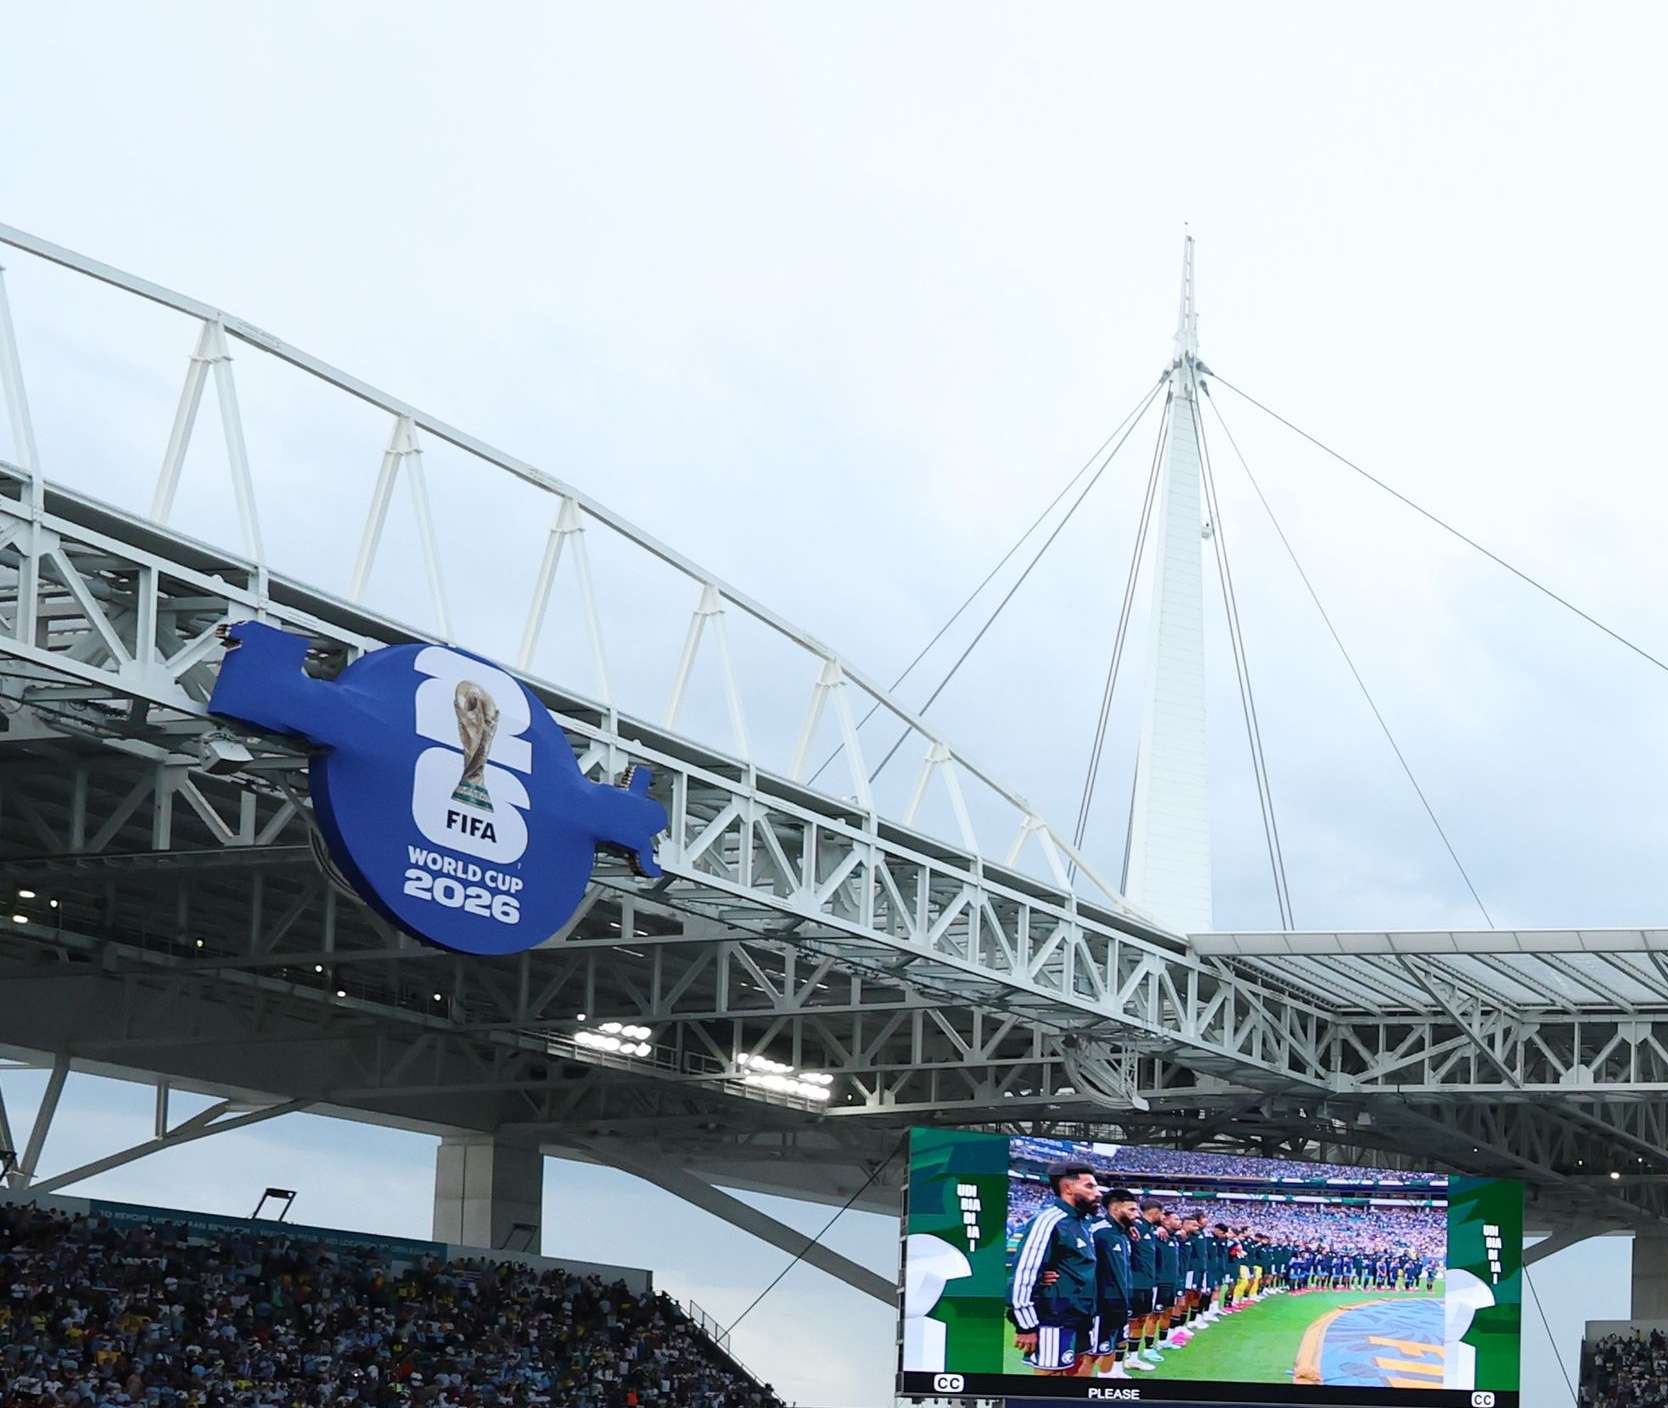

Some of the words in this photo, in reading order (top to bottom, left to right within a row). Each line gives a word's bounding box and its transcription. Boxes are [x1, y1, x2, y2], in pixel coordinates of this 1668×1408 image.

[447, 809, 497, 844] FIFA
[408, 845, 483, 882] WORLD
[484, 868, 524, 893] CUP
[403, 868, 521, 925] 2026
[940, 1377, 958, 1390] CC
[1088, 1387, 1140, 1400] PLEASE
[1474, 1394, 1492, 1405] CC
